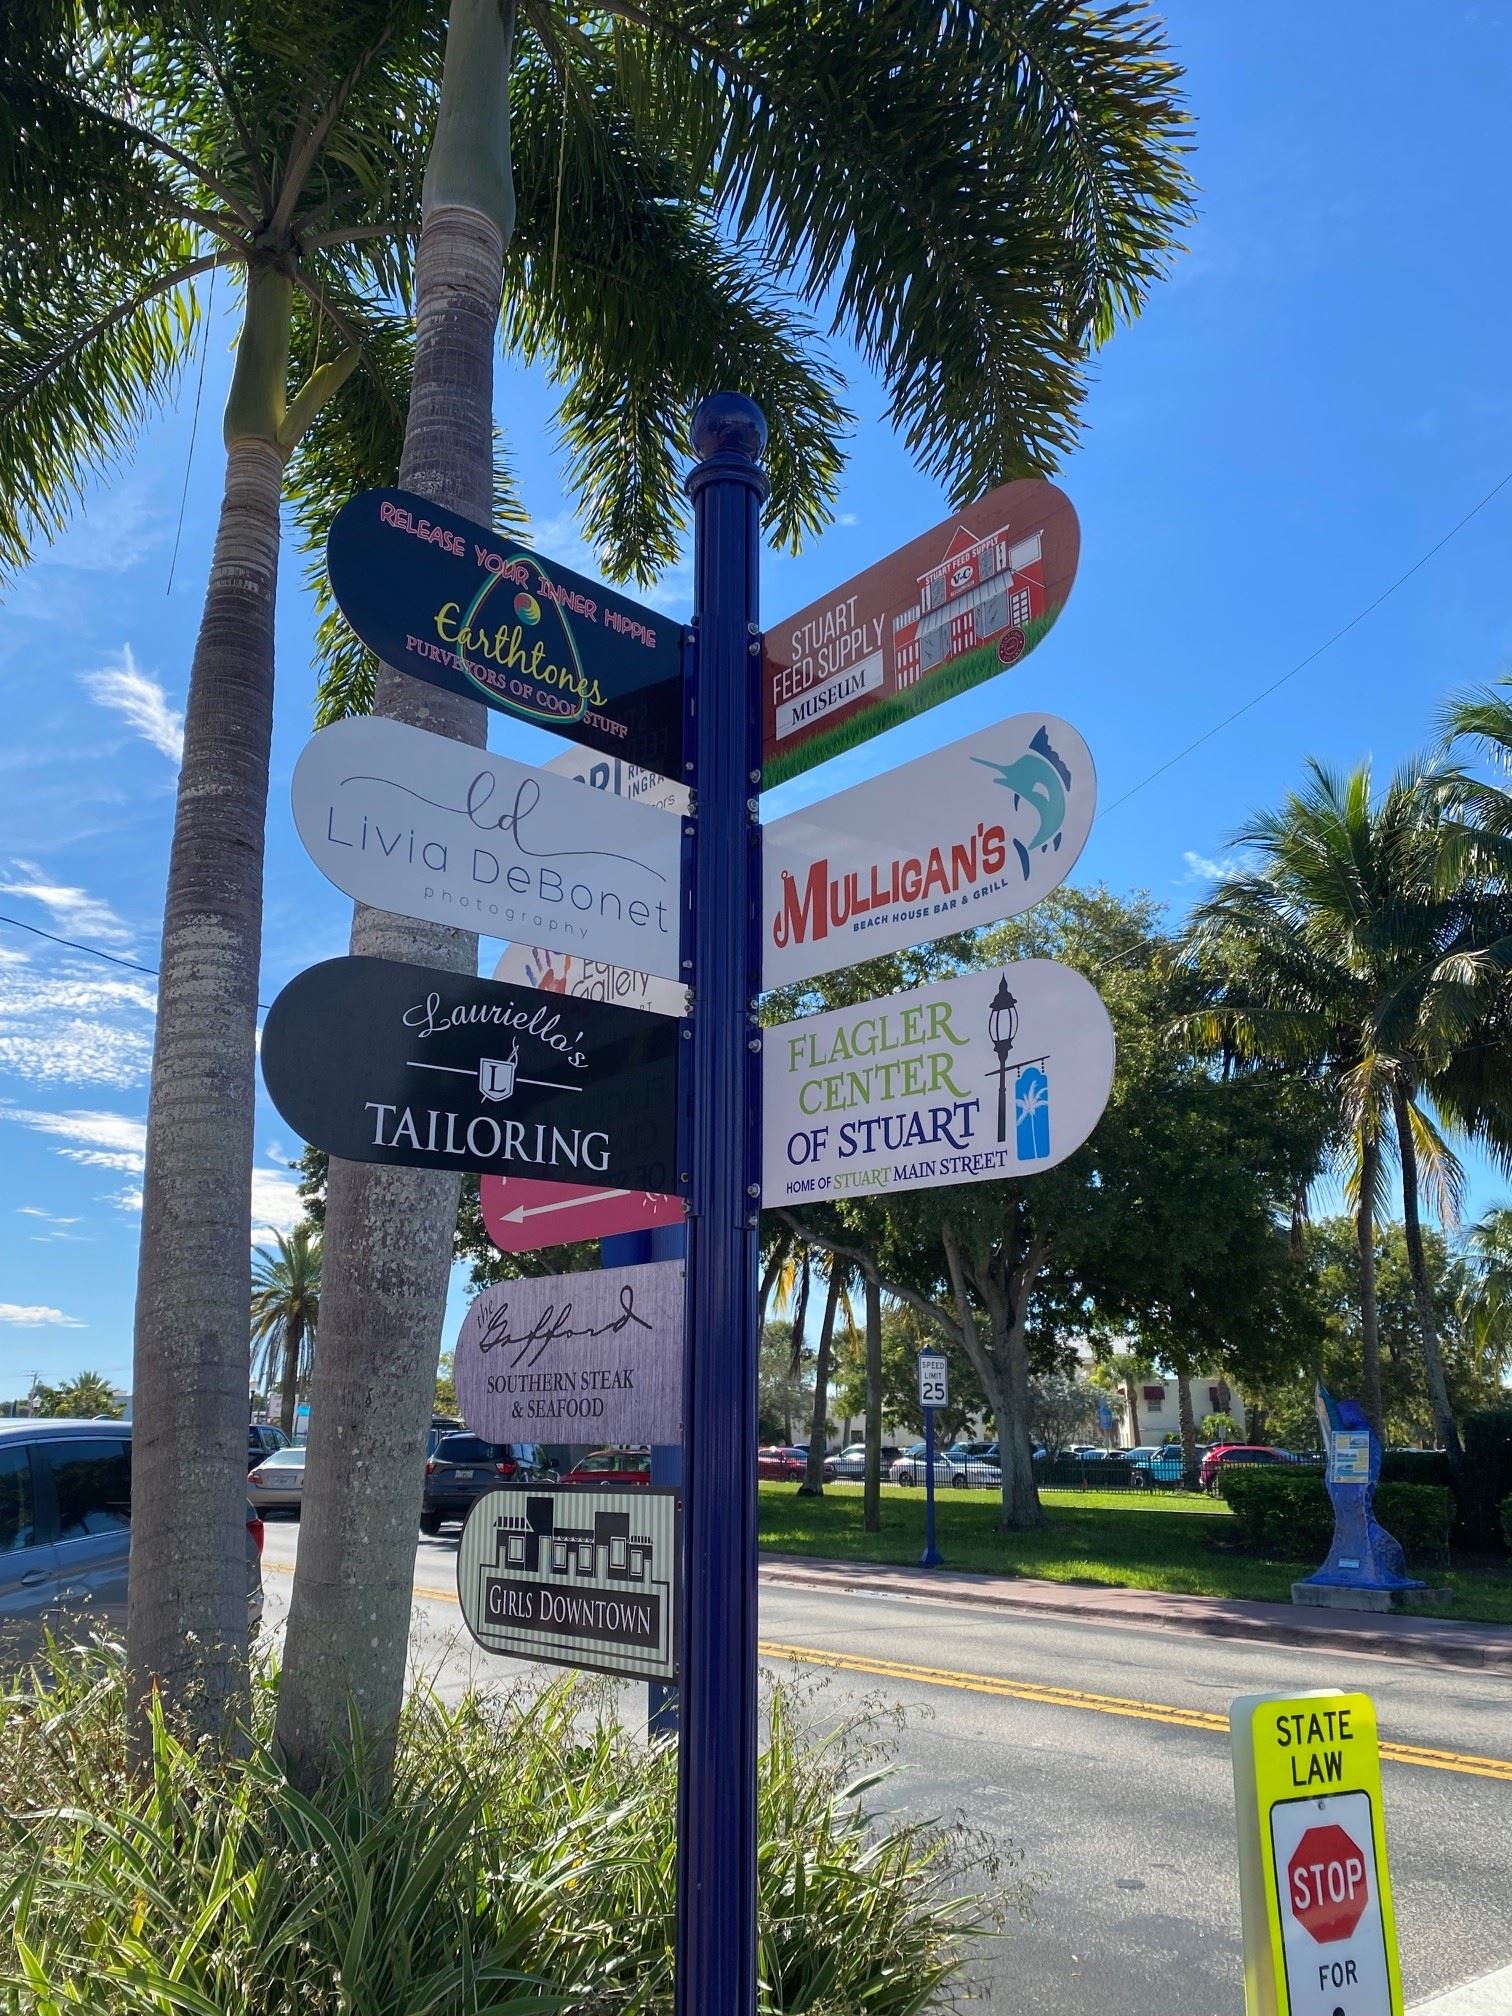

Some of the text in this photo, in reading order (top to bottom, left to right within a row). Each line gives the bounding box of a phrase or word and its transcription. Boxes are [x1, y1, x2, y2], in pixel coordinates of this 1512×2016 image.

[380, 501, 657, 648] RELEASE YOUR INNER HIPPIE
[925, 536, 999, 585] STUART FEED SUPPLY
[434, 602, 608, 706] Earthtones
[791, 595, 858, 661] STUART
[405, 634, 628, 738] PURVEYORS OF COOL STUFF
[773, 613, 886, 705] FEED SUPPLY
[791, 669, 866, 726] MUSEUM
[327, 806, 668, 933] Livia DeBonet
[773, 822, 1007, 949] MULLIGAN'S
[423, 885, 590, 939] photography
[853, 878, 1009, 932] BEACH HOUSE BAR & GRILL
[788, 1001, 970, 1072] FLAGLER
[799, 1052, 972, 1115] CENTER
[364, 1101, 611, 1171] TAILORING
[787, 1098, 980, 1166] OF STUART
[786, 1150, 1008, 1194] HOME OF STUART MAIN STREET
[477, 1300, 493, 1329] the
[487, 1369, 634, 1393] SOUTHERN STEAK
[922, 1361, 944, 1369] SPEED
[923, 1383, 945, 1400] 25
[512, 1398, 604, 1418] & SEAFOOD
[489, 1584, 651, 1636] GIRLS DOWNTOWN
[1276, 1710, 1354, 1747] STATE
[1291, 1751, 1343, 1787] LAW
[1293, 1858, 1362, 1910] STOP
[1319, 1960, 1358, 1991] FOR
